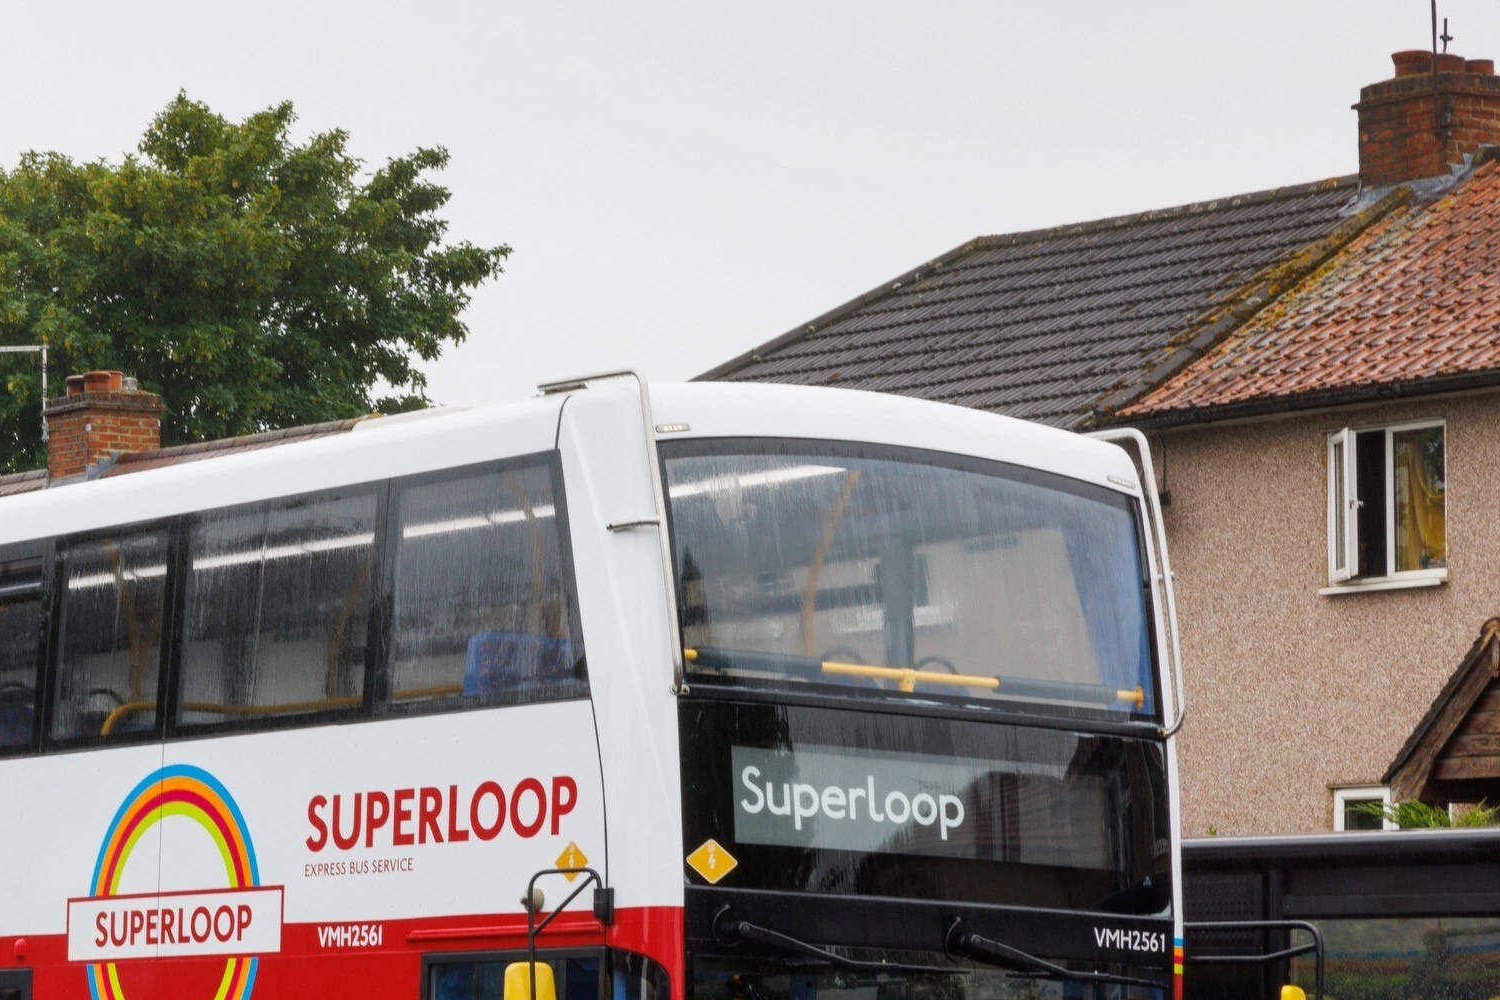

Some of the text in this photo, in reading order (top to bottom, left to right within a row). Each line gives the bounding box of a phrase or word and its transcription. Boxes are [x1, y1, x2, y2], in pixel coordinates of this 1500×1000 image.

[305, 775, 578, 853] SUPERLOOP
[740, 765, 965, 841] Superloop
[304, 857, 414, 877] EXPRESS BUS SERVICE
[94, 904, 253, 947] SUPERLOOP
[317, 924, 383, 948] VMH2561
[1093, 926, 1166, 953] VMH2561
